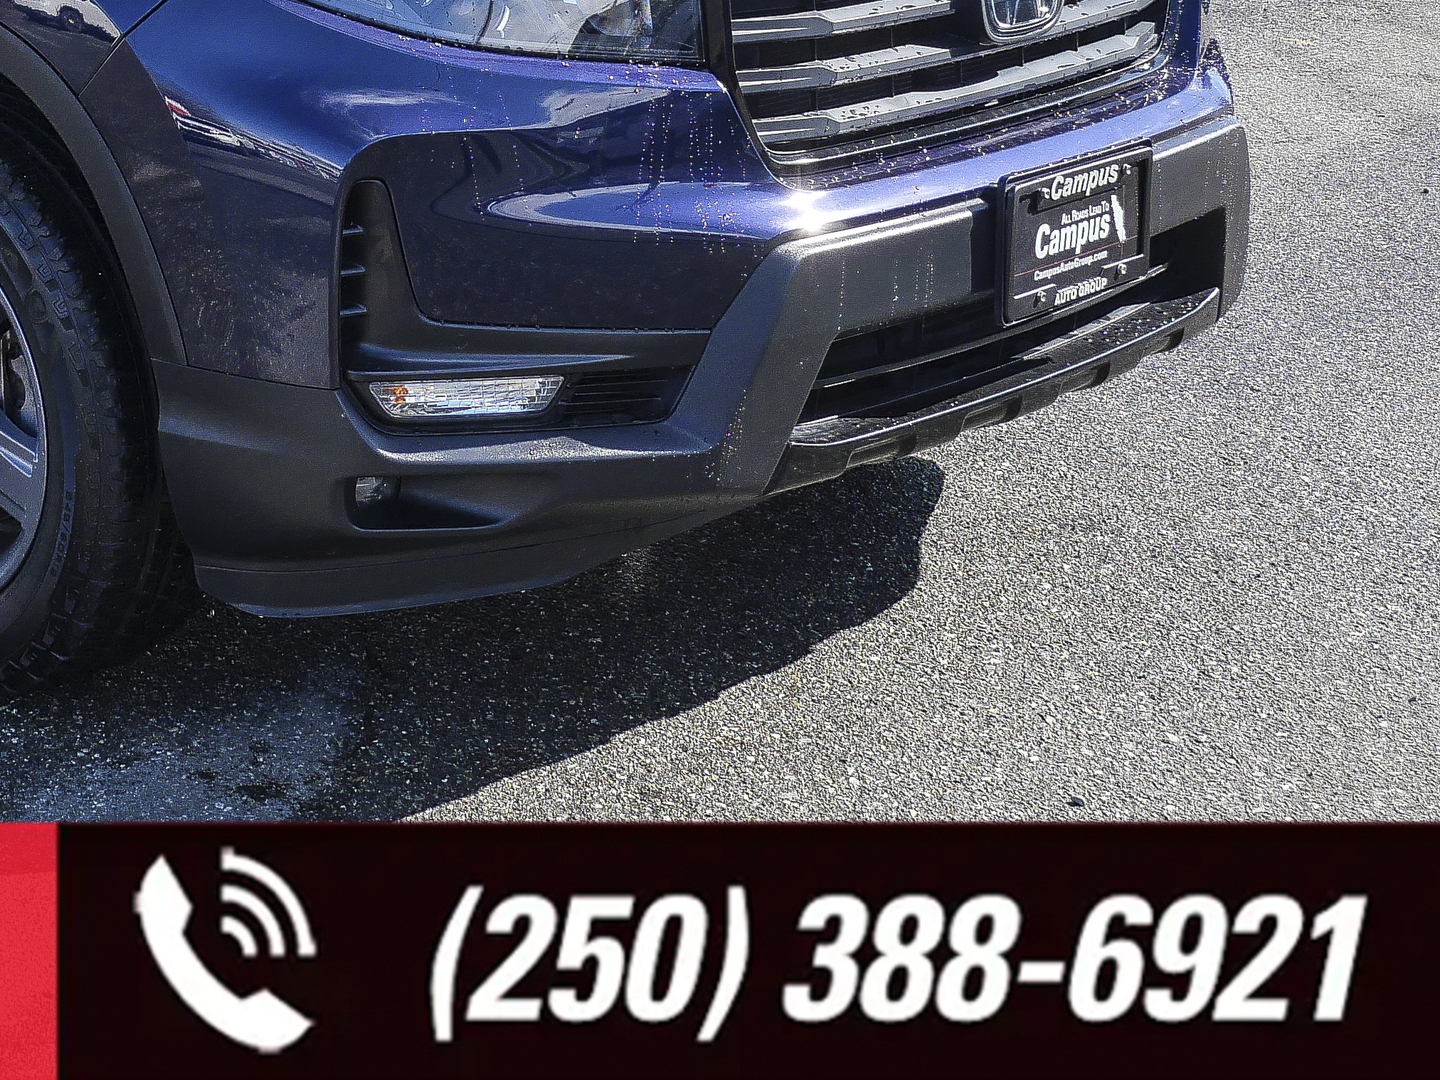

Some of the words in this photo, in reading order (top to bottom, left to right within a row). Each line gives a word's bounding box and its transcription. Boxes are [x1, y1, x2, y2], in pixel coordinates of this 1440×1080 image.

[1050, 163, 1119, 201] Campus
[1034, 213, 1111, 260] Campus
[1033, 249, 1108, 281] CampusAutoGroup.com
[1054, 286, 1078, 306] AUTO
[1078, 277, 1109, 297] GROUP
